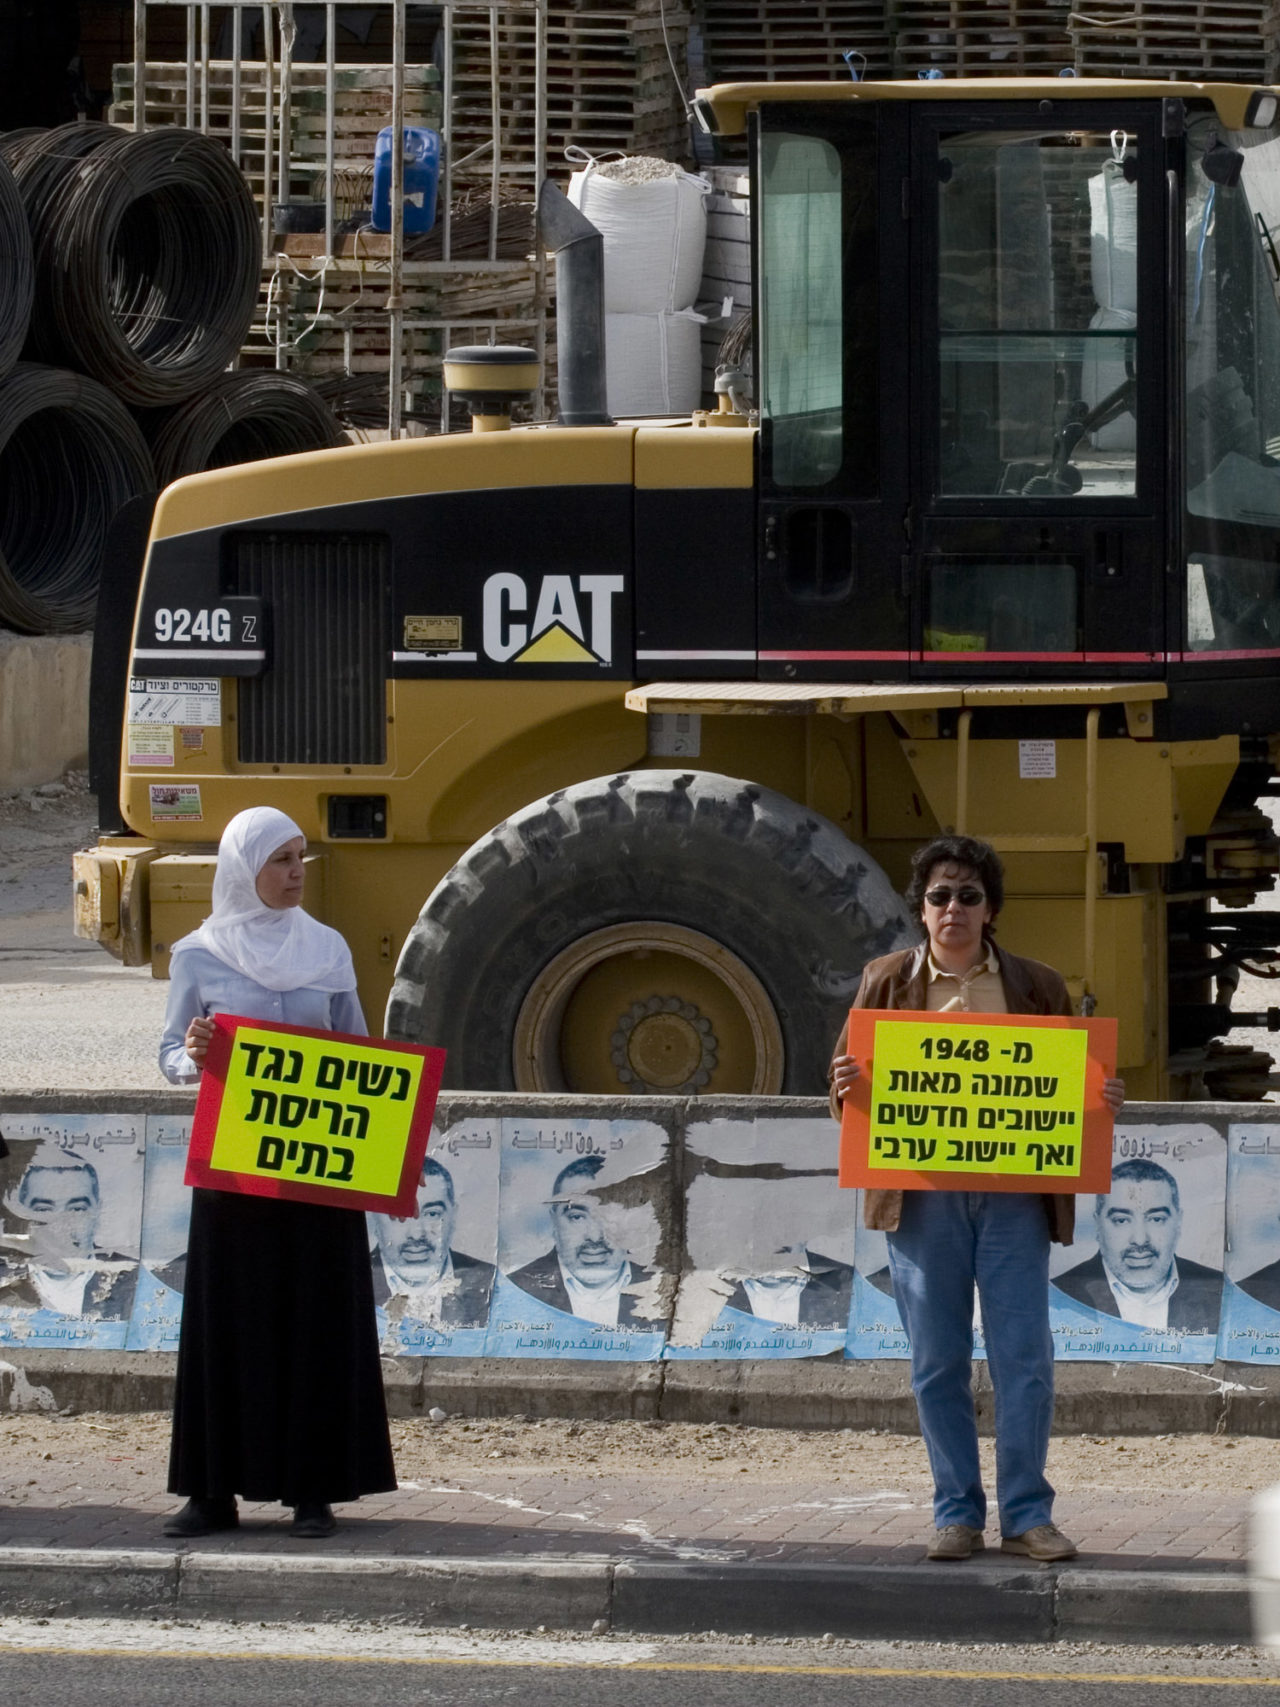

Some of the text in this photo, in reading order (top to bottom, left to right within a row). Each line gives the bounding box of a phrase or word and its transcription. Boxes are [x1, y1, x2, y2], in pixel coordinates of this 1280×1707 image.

[155, 608, 257, 642] 924G Z
[483, 572, 624, 662] CAT
[173, 681, 217, 693] טרקטורים
[920, 1038, 990, 1062] 1948
[239, 1042, 411, 1101] נשים נגד
[888, 1069, 1058, 1098] שמונה מאות
[244, 1089, 370, 1140] הריסת
[877, 1103, 1075, 1131] יישובים חדשים
[256, 1135, 355, 1182] בתים
[874, 1136, 1074, 1171] ואף יישוב ערבי
